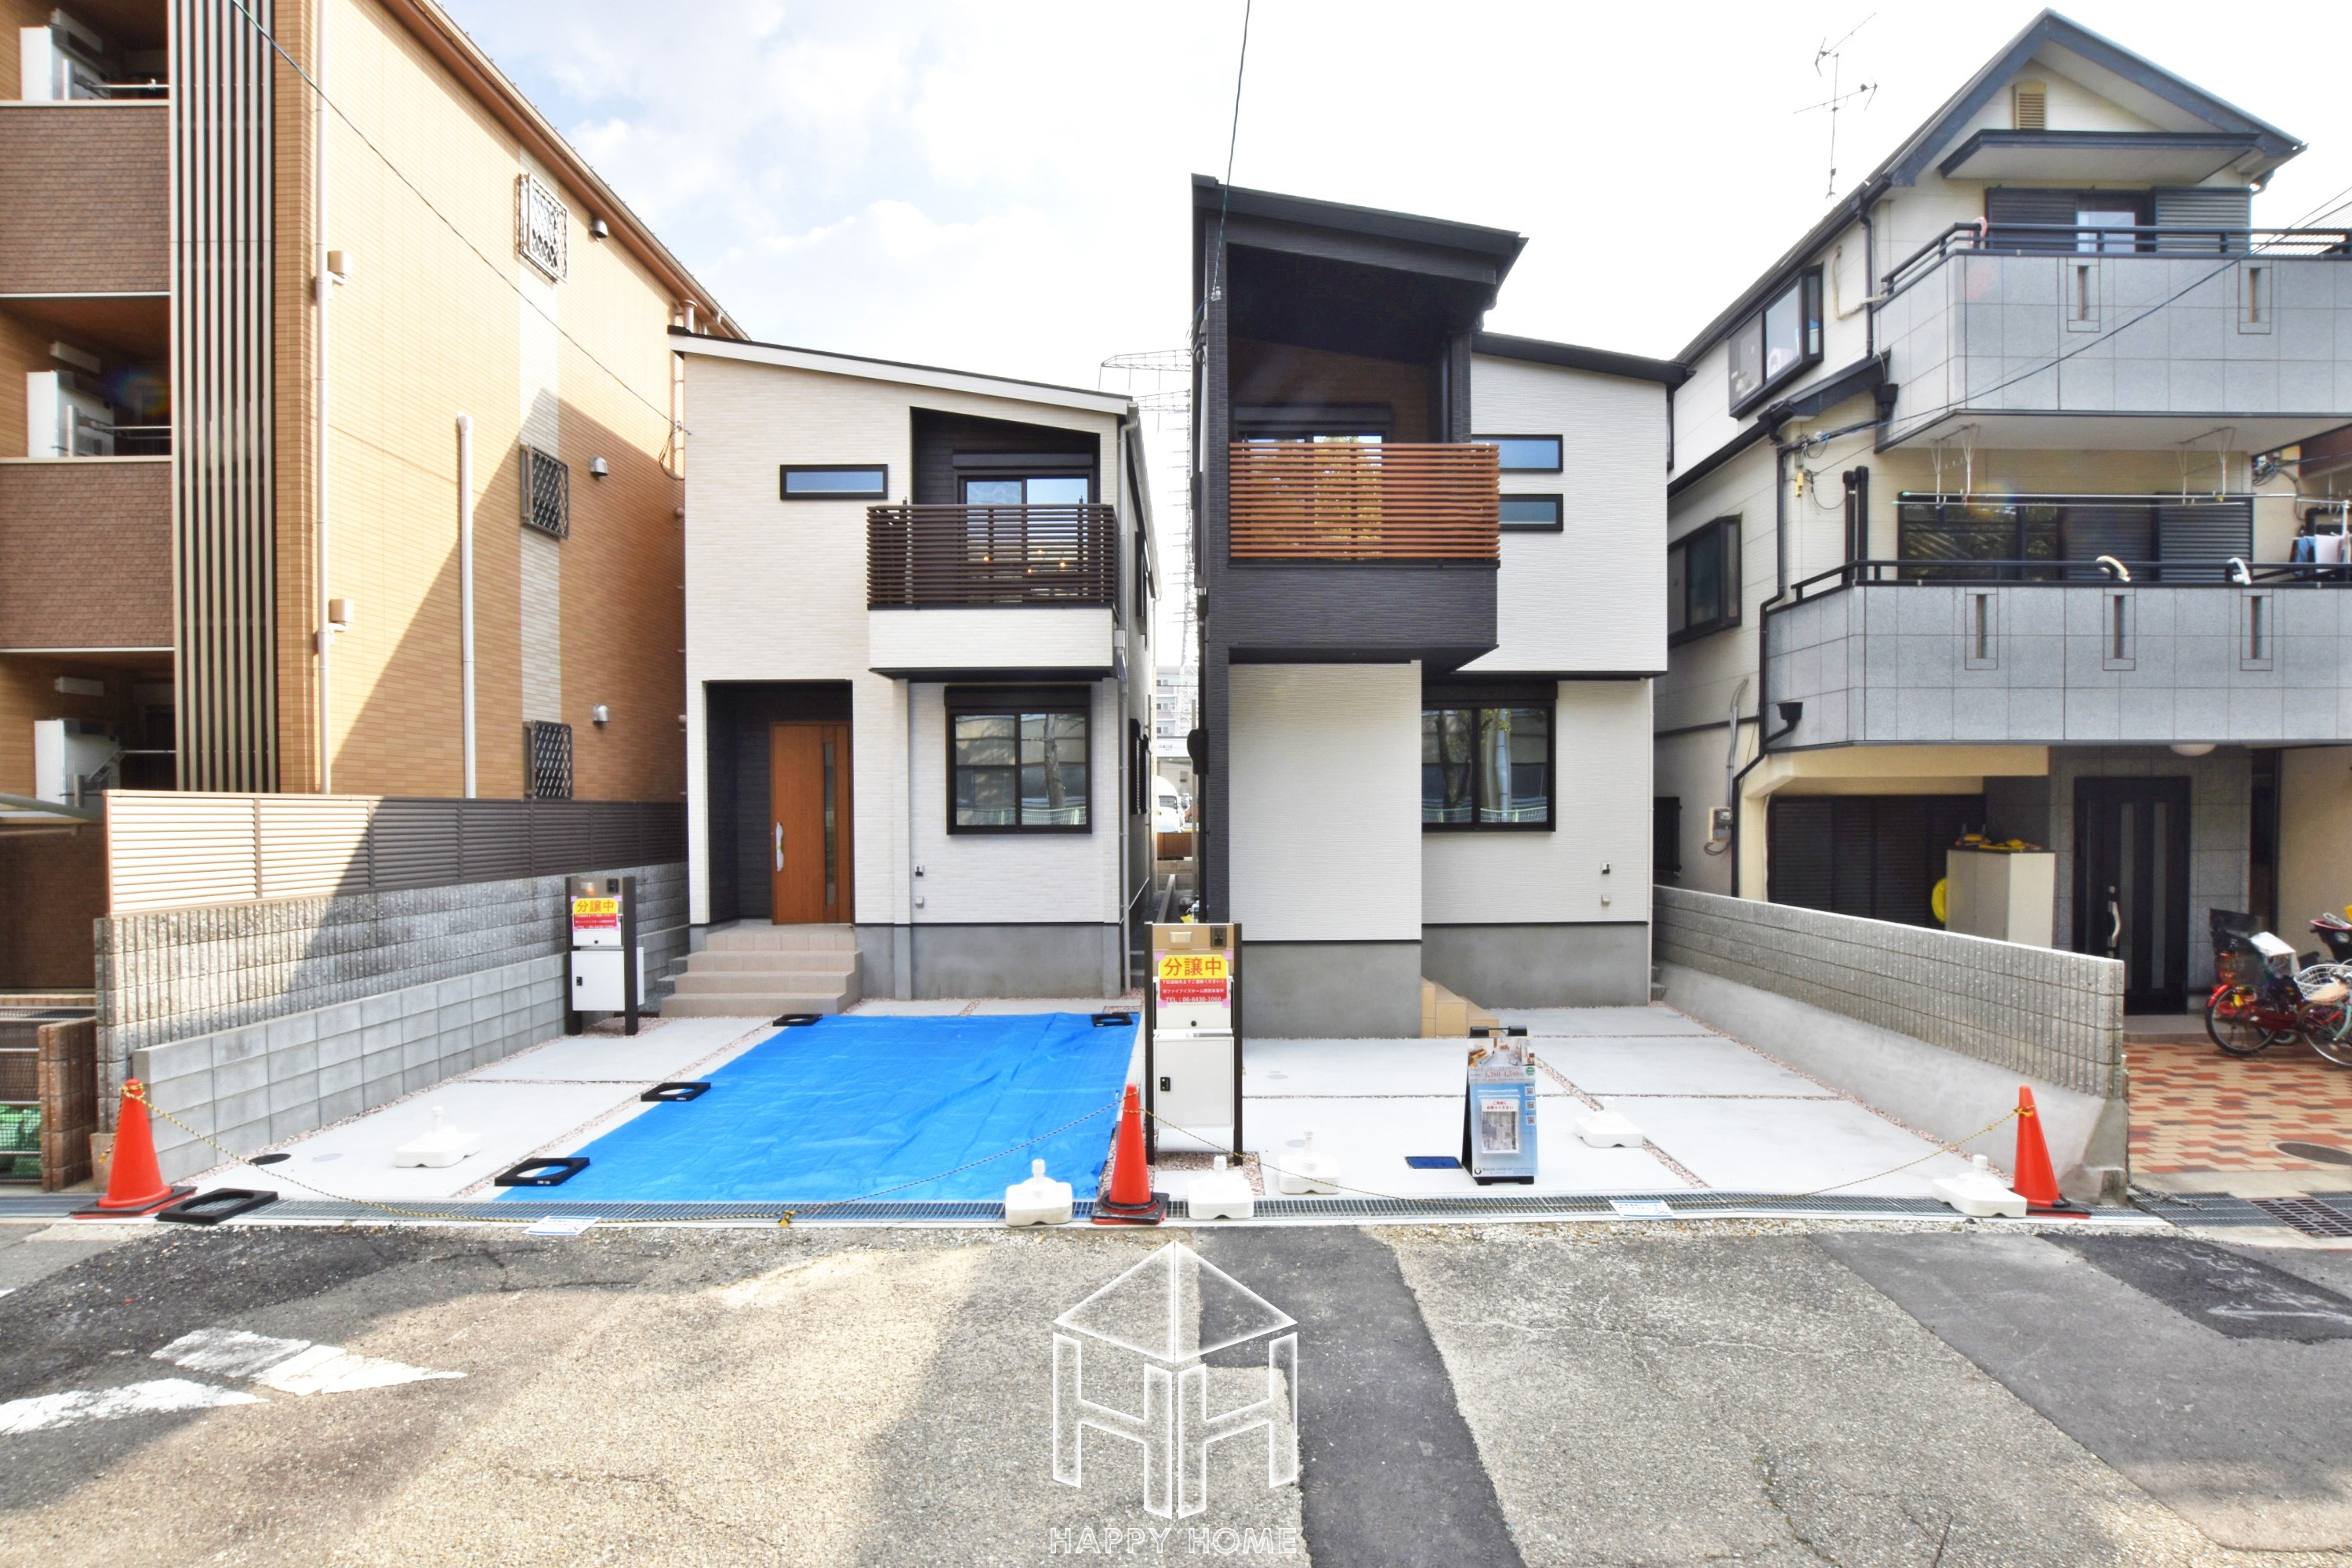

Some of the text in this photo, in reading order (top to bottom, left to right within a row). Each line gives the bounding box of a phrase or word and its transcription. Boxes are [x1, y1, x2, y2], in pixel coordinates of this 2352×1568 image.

[577, 900, 615, 912] 分譲中
[1164, 957, 1221, 976] 分譲中
